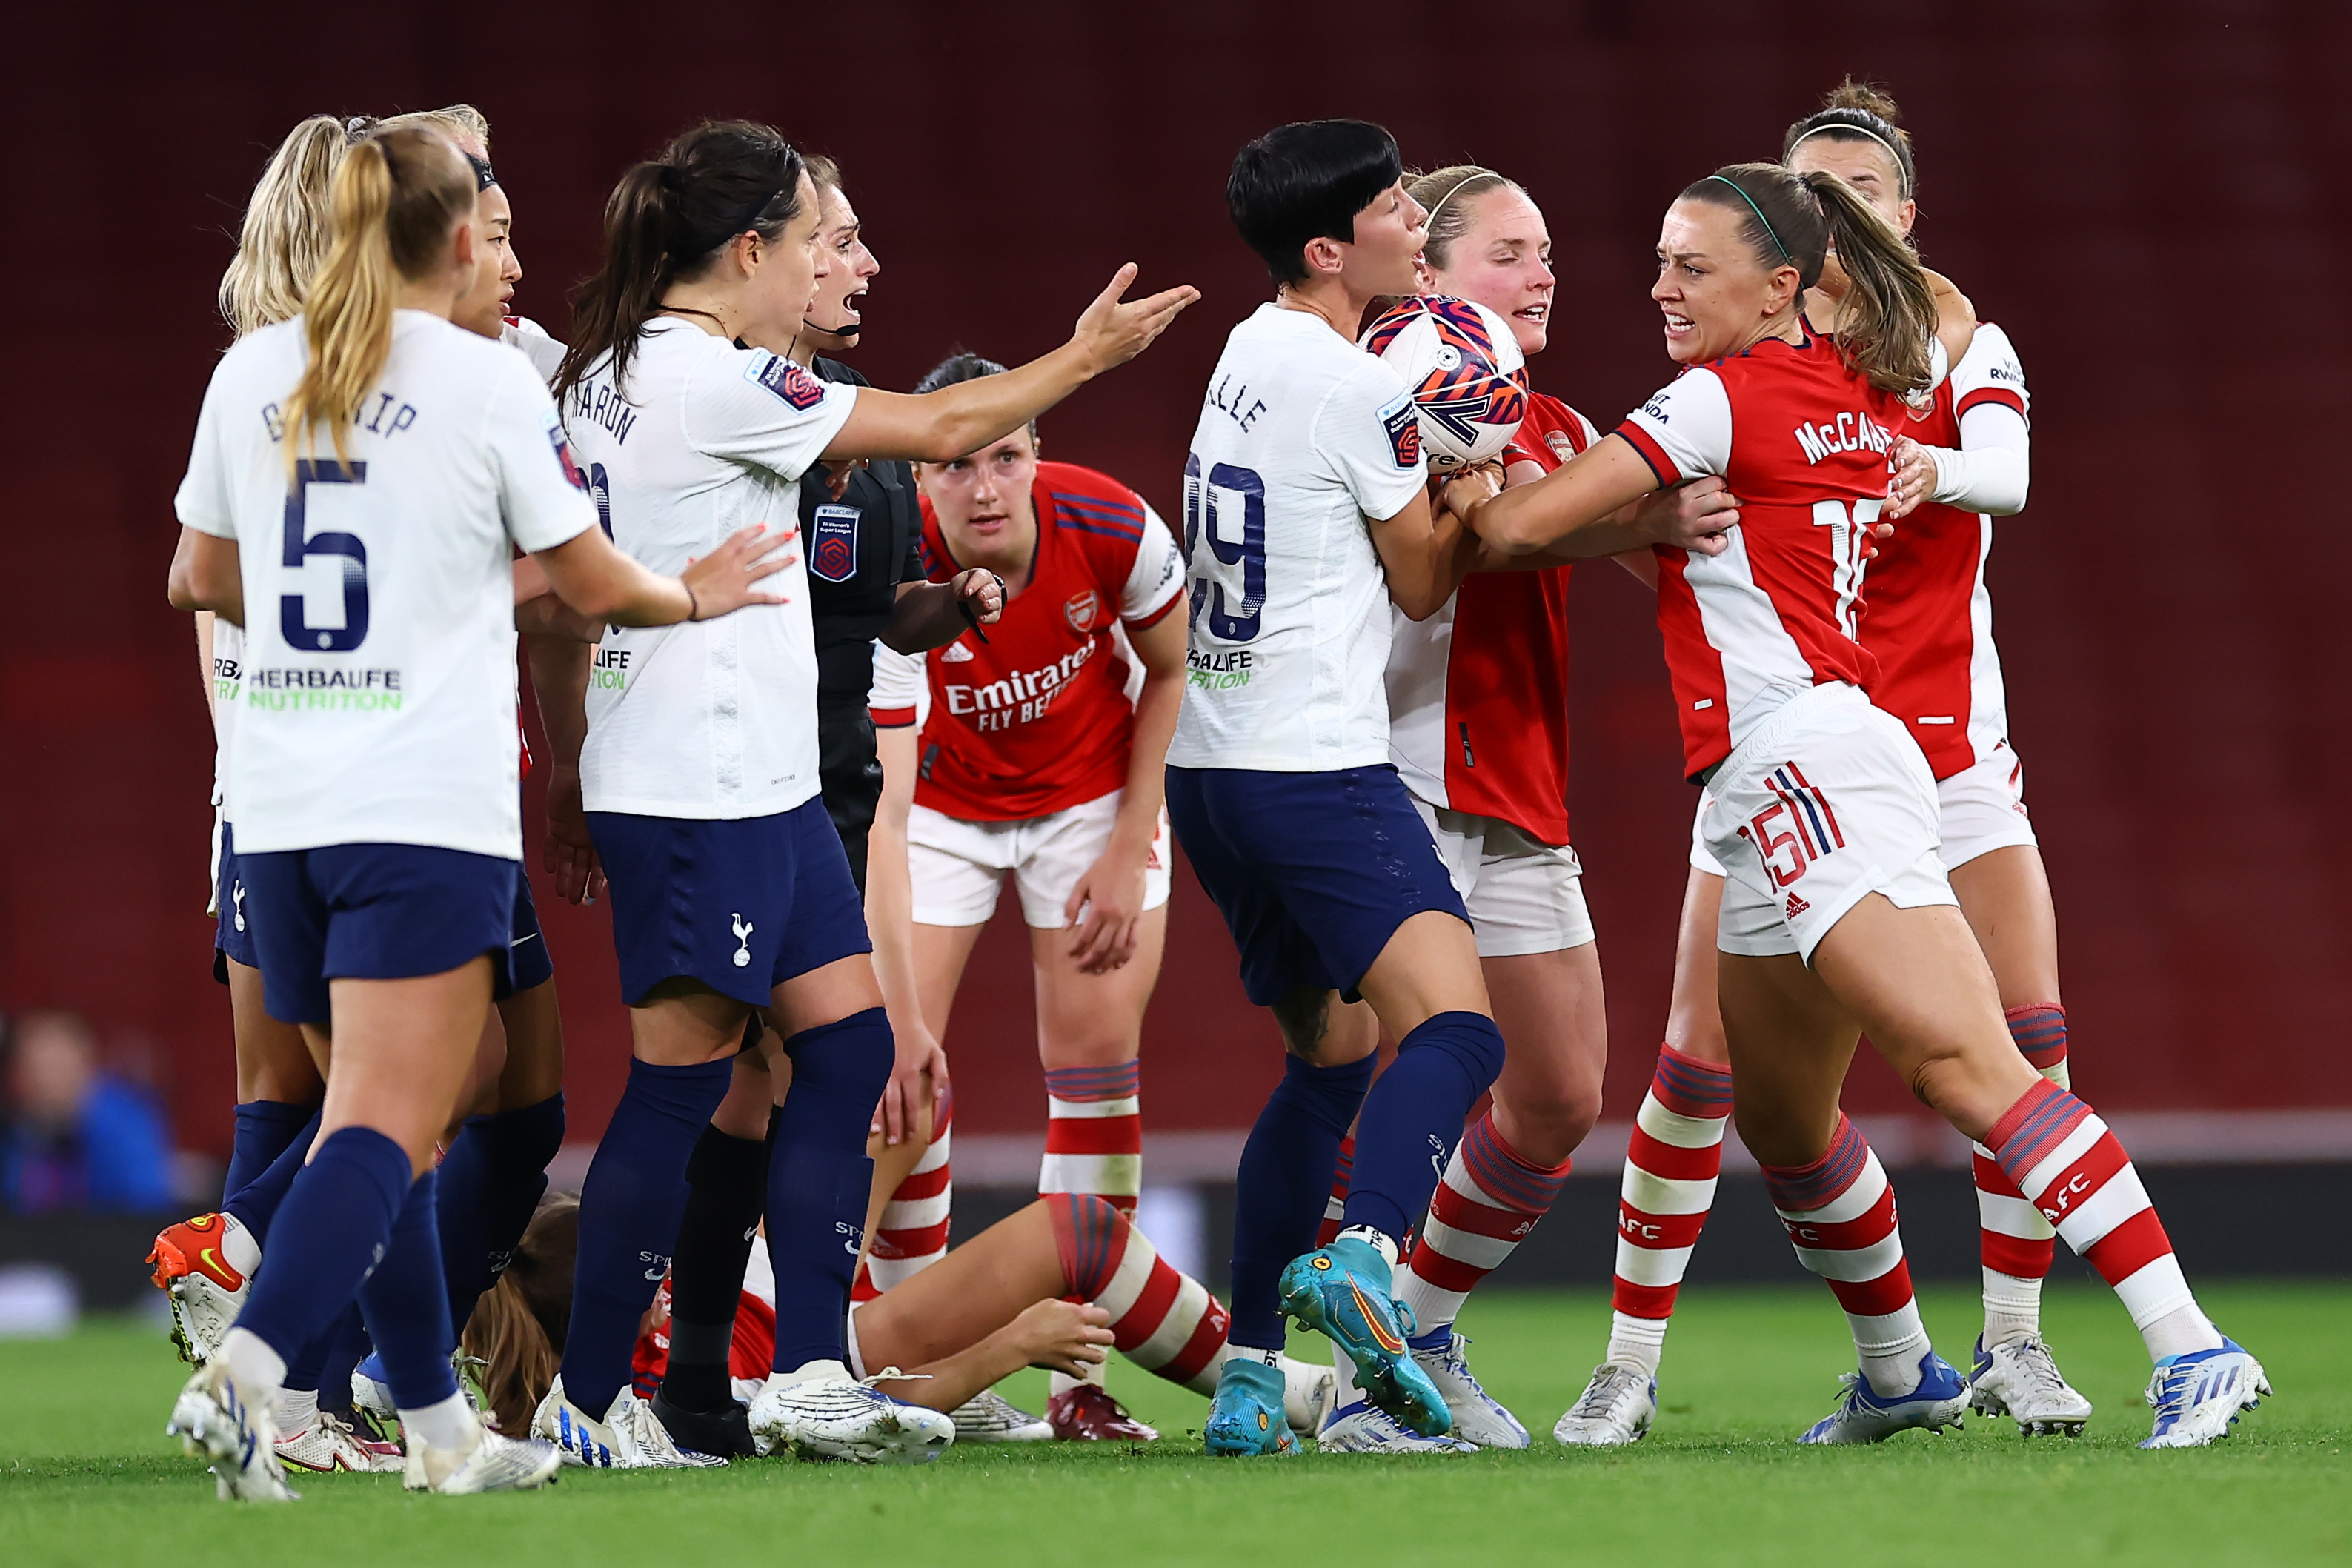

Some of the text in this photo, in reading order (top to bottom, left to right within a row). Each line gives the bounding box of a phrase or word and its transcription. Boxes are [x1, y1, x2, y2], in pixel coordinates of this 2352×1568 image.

[281, 459, 369, 652] 5
[249, 668, 402, 691] HERBALIFE
[248, 690, 402, 712] NUTRITION
[977, 708, 1014, 732] FLY
[1786, 900, 1810, 920] adidas
[2042, 1172, 2092, 1221] AFC
